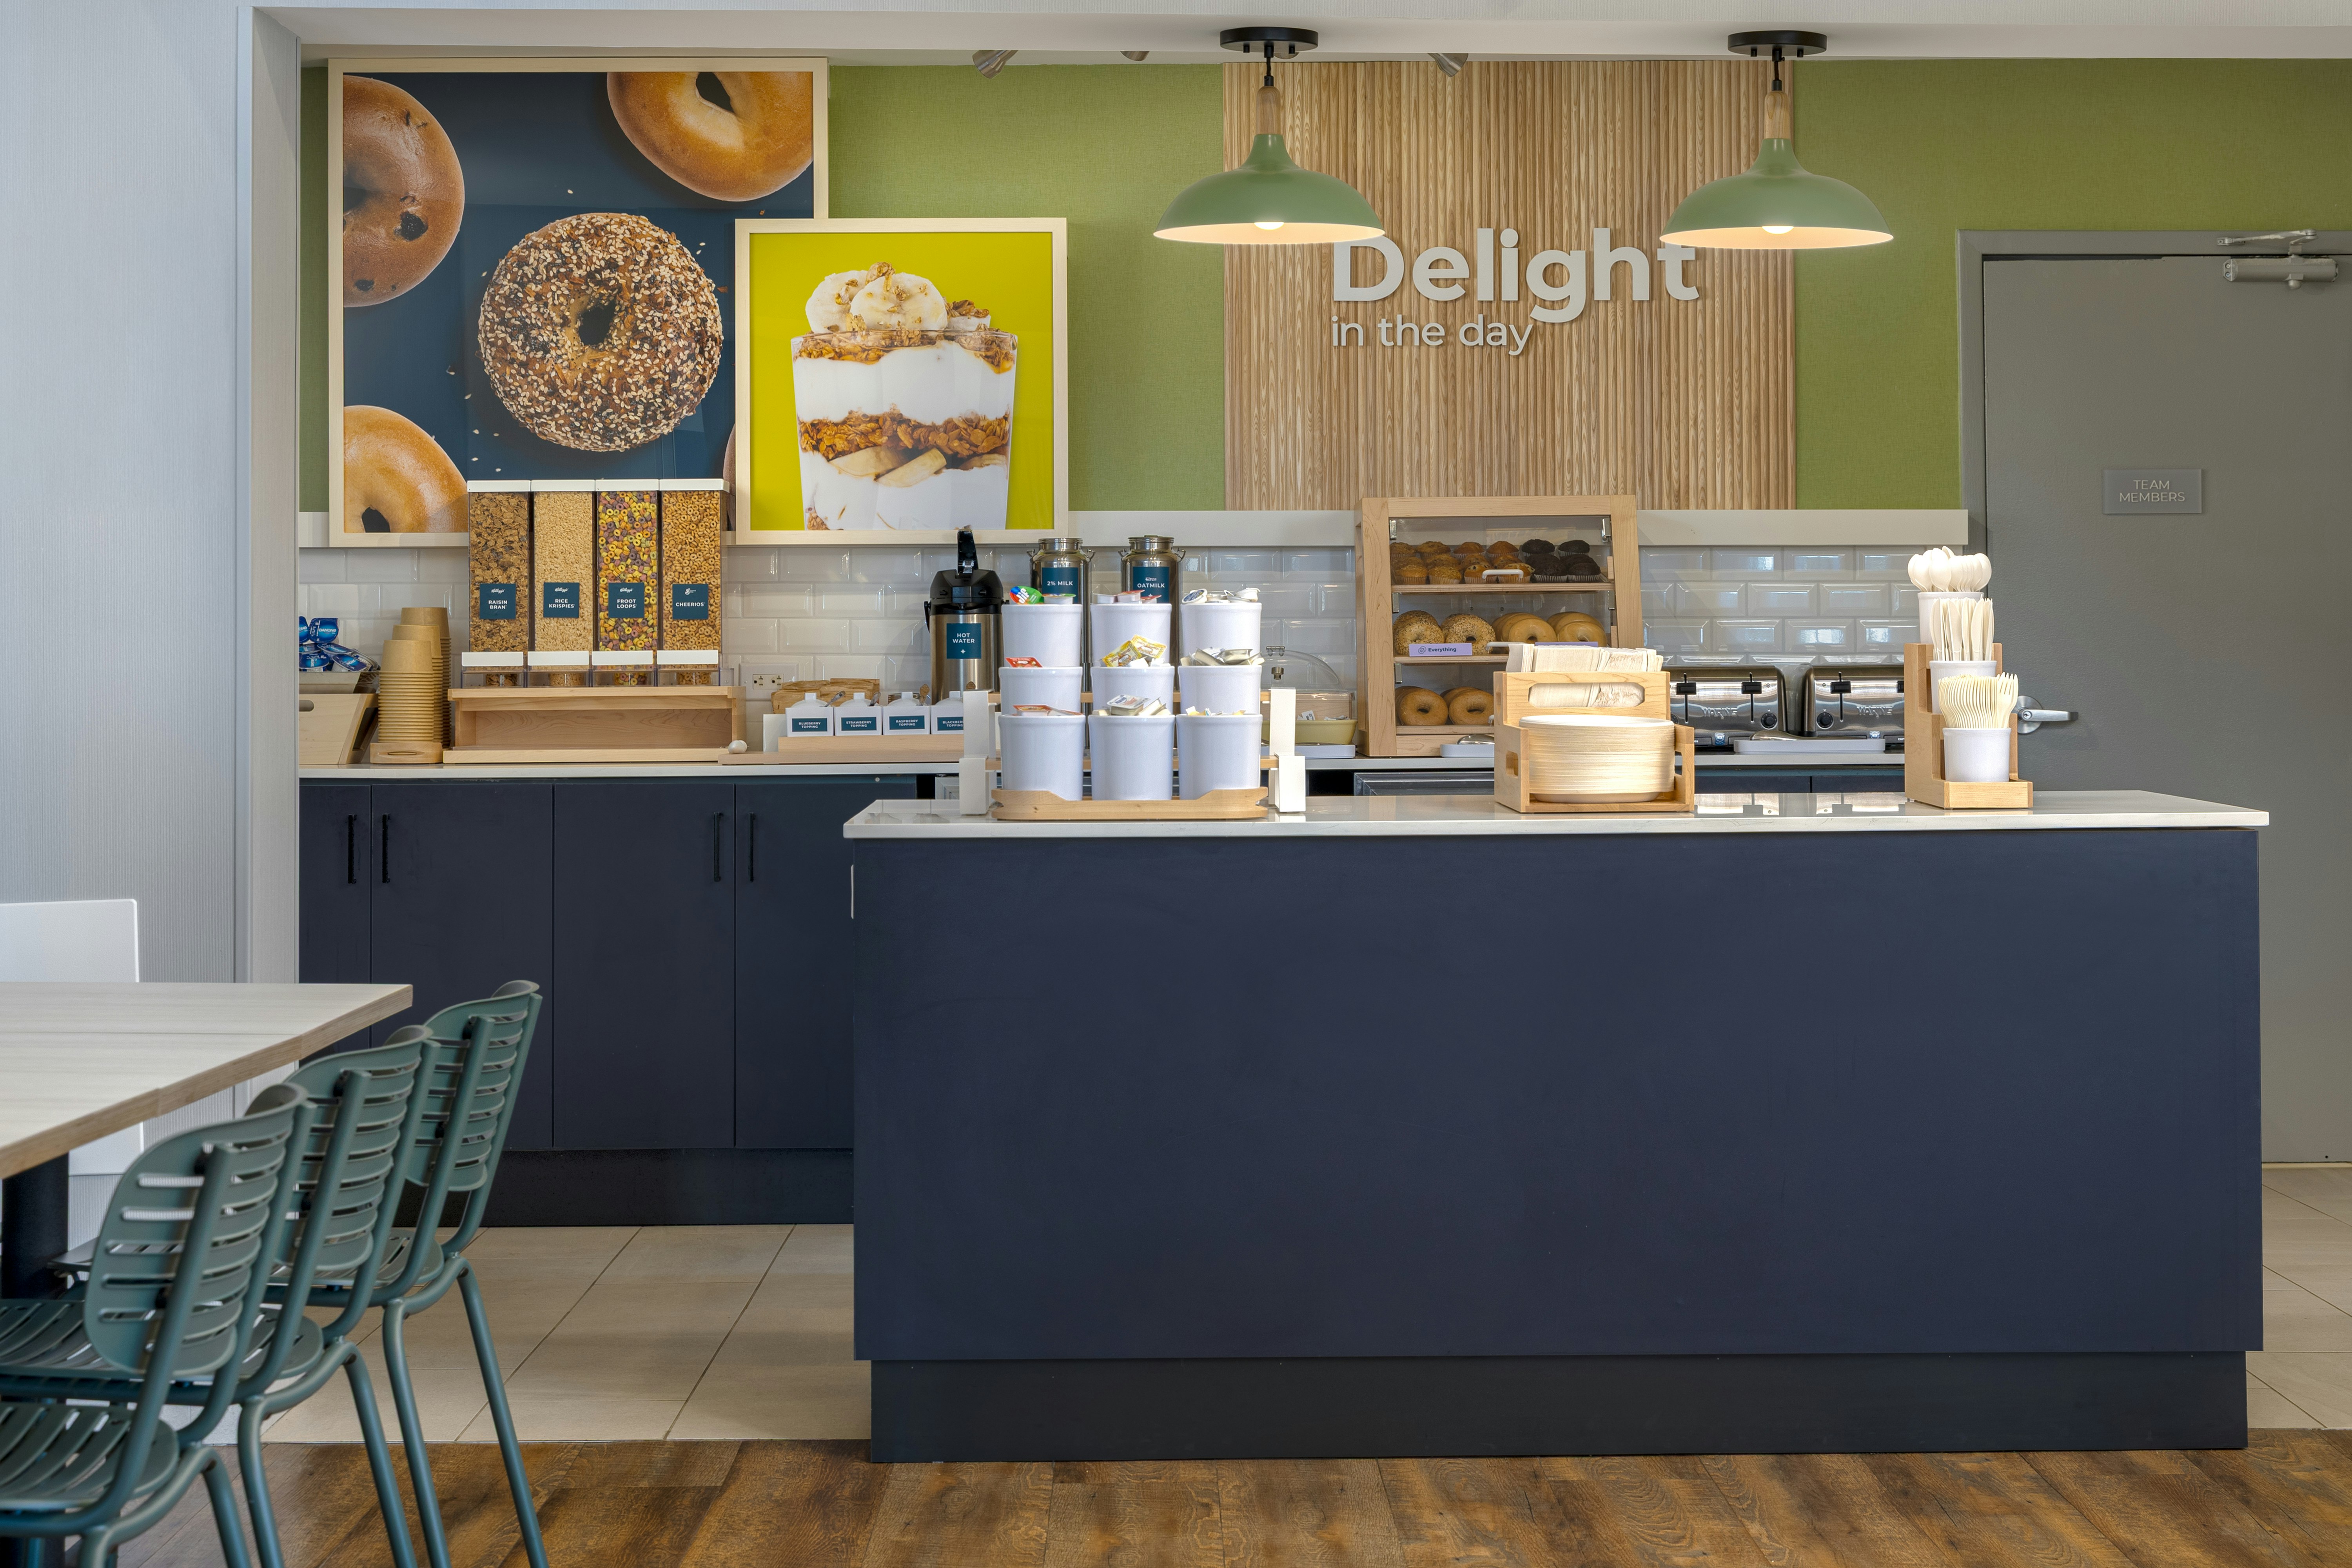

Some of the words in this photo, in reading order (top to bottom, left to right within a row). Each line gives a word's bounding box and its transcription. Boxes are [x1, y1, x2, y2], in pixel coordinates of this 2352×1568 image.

[1333, 228, 1699, 323] Delight
[1332, 316, 1363, 346] in
[1378, 314, 1445, 346] the
[1459, 314, 1534, 356] day
[2119, 492, 2185, 503] MEMBERS
[2133, 479, 2170, 490] TEAM
